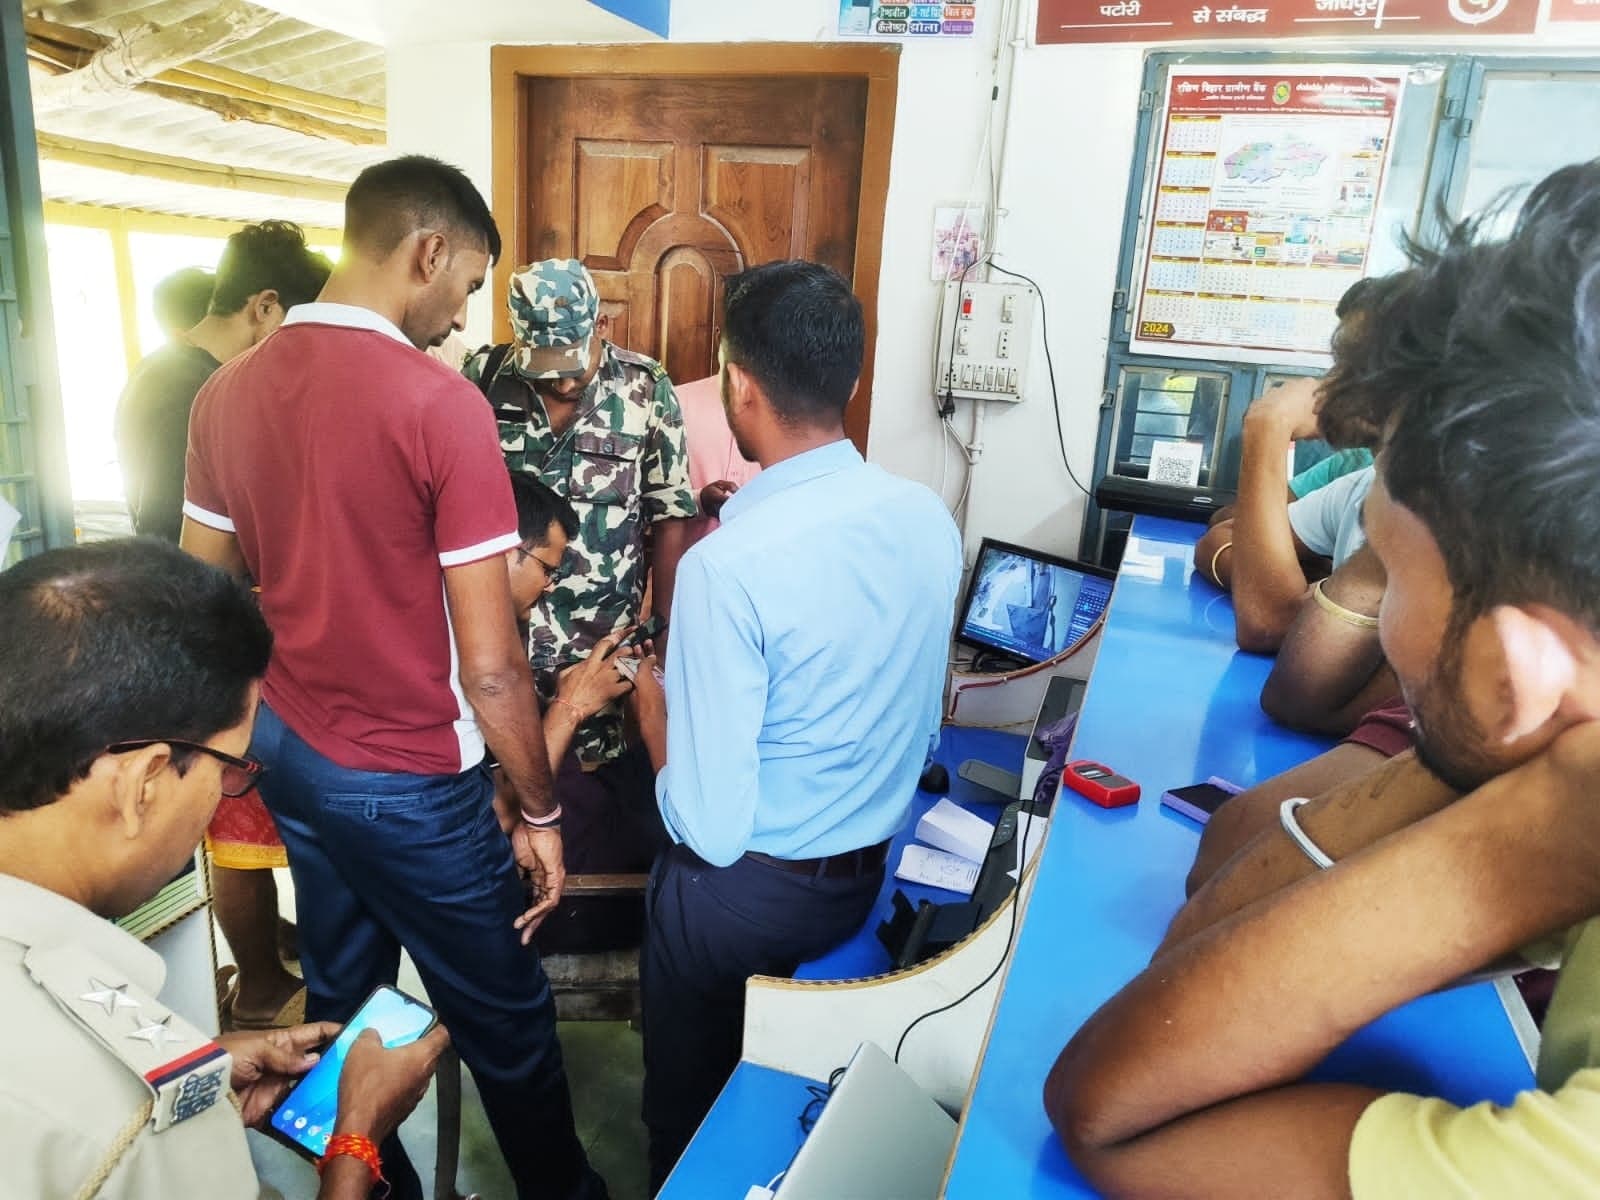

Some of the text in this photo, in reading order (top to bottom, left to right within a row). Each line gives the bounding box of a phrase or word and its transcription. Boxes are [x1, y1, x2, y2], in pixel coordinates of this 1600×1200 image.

[1100, 1, 1141, 17] पटोरी
[1193, 8, 1210, 23] से
[1143, 322, 1169, 333] 2024
